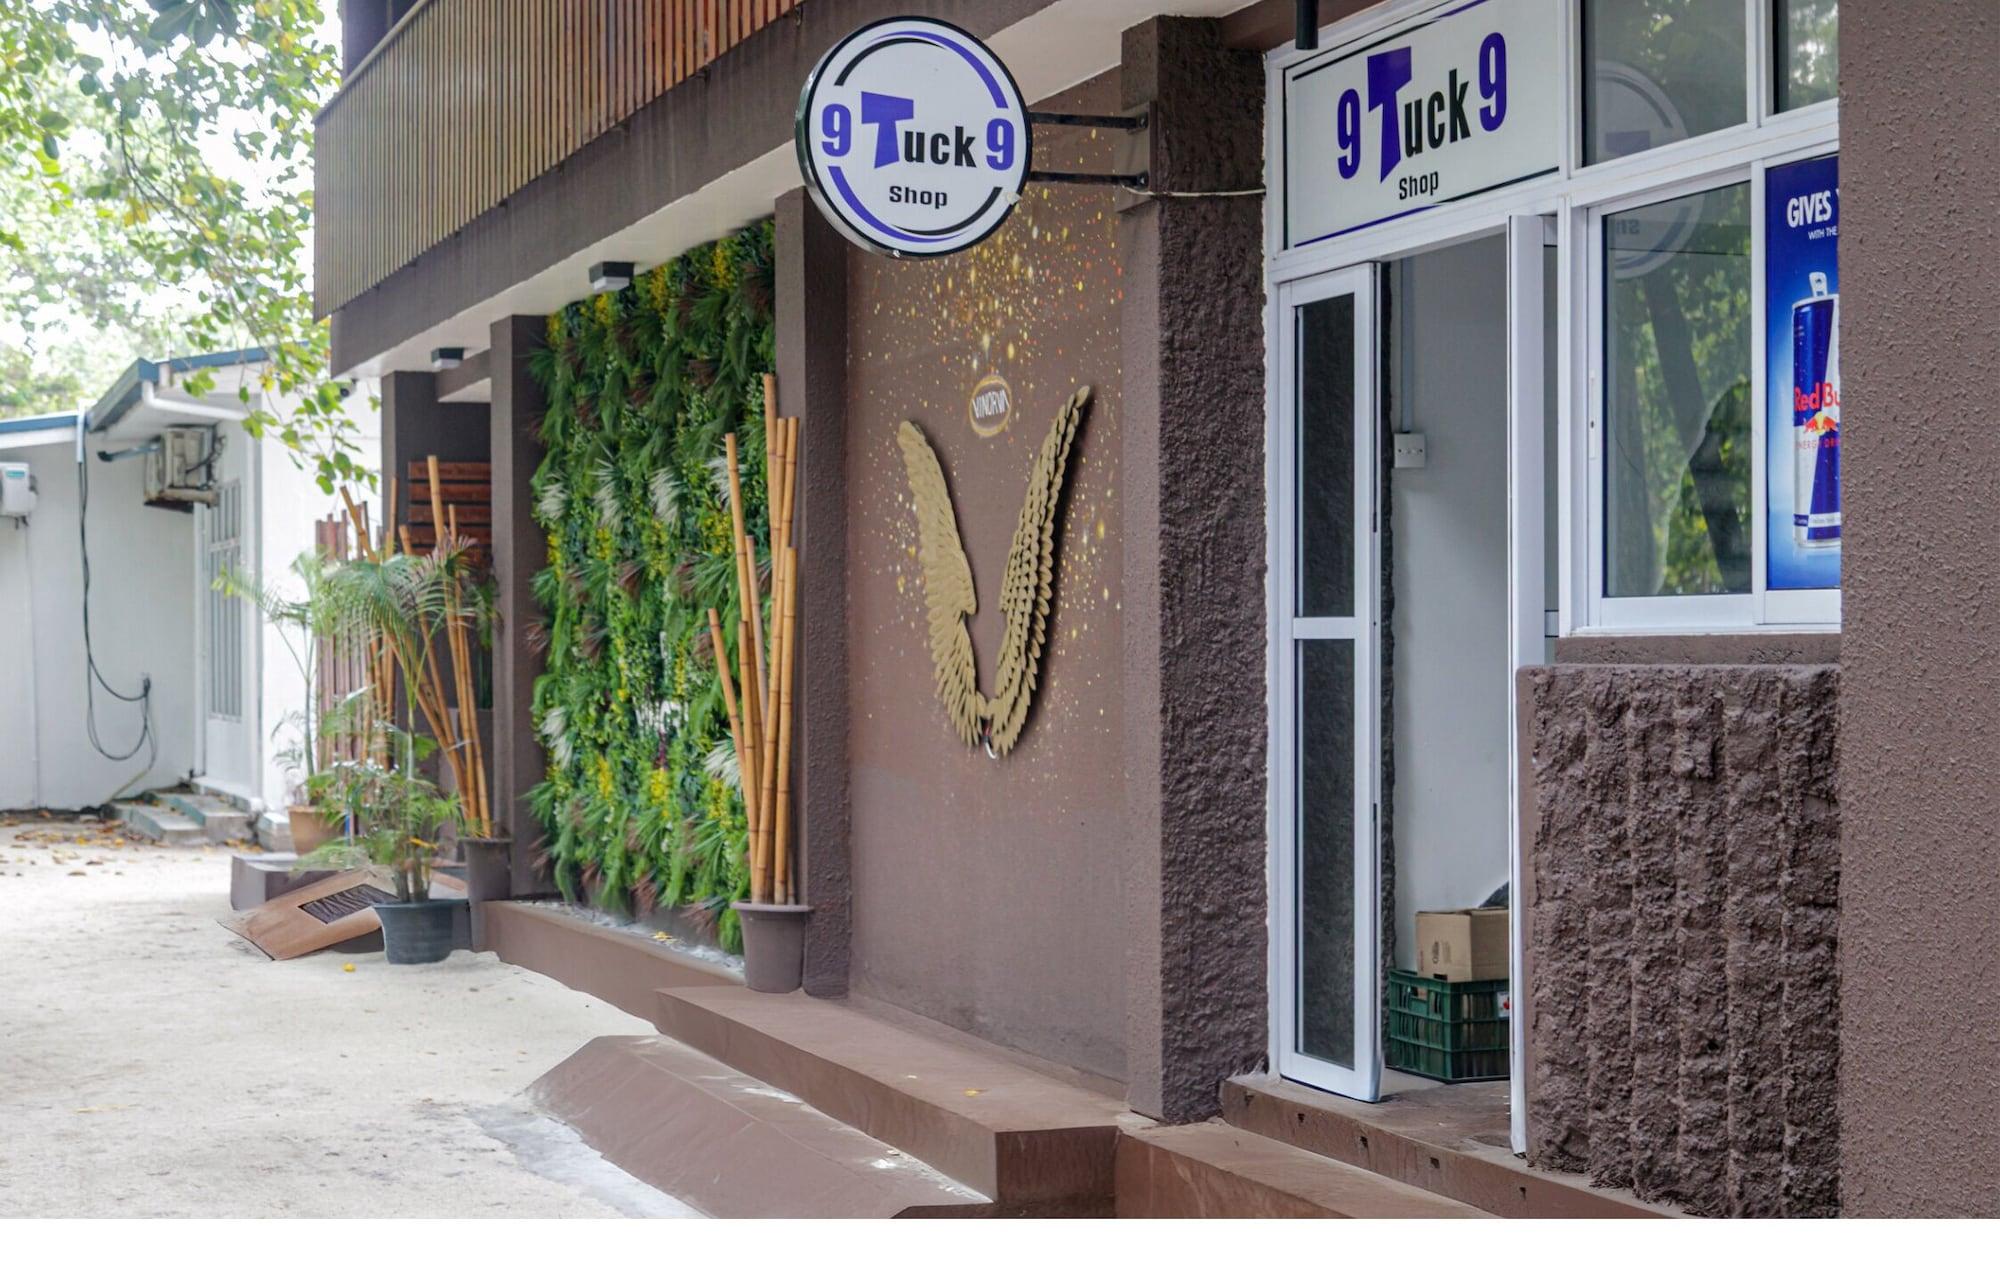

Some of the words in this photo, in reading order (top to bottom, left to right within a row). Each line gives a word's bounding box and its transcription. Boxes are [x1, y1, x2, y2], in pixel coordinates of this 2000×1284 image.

[1337, 88, 1361, 180] 9
[1367, 46, 1471, 184] Tuck
[1478, 32, 1507, 132] 9
[821, 103, 852, 158] 9
[861, 91, 977, 170] Tuck
[985, 118, 1015, 171] 9
[888, 185, 948, 209] Shop
[1399, 171, 1439, 201] Shop
[1786, 190, 1832, 228] GIVES
[1808, 228, 1825, 240] WITH
[1826, 226, 1838, 236] THE
[1794, 382, 1820, 411] Red
[1823, 383, 1840, 407] Bu
